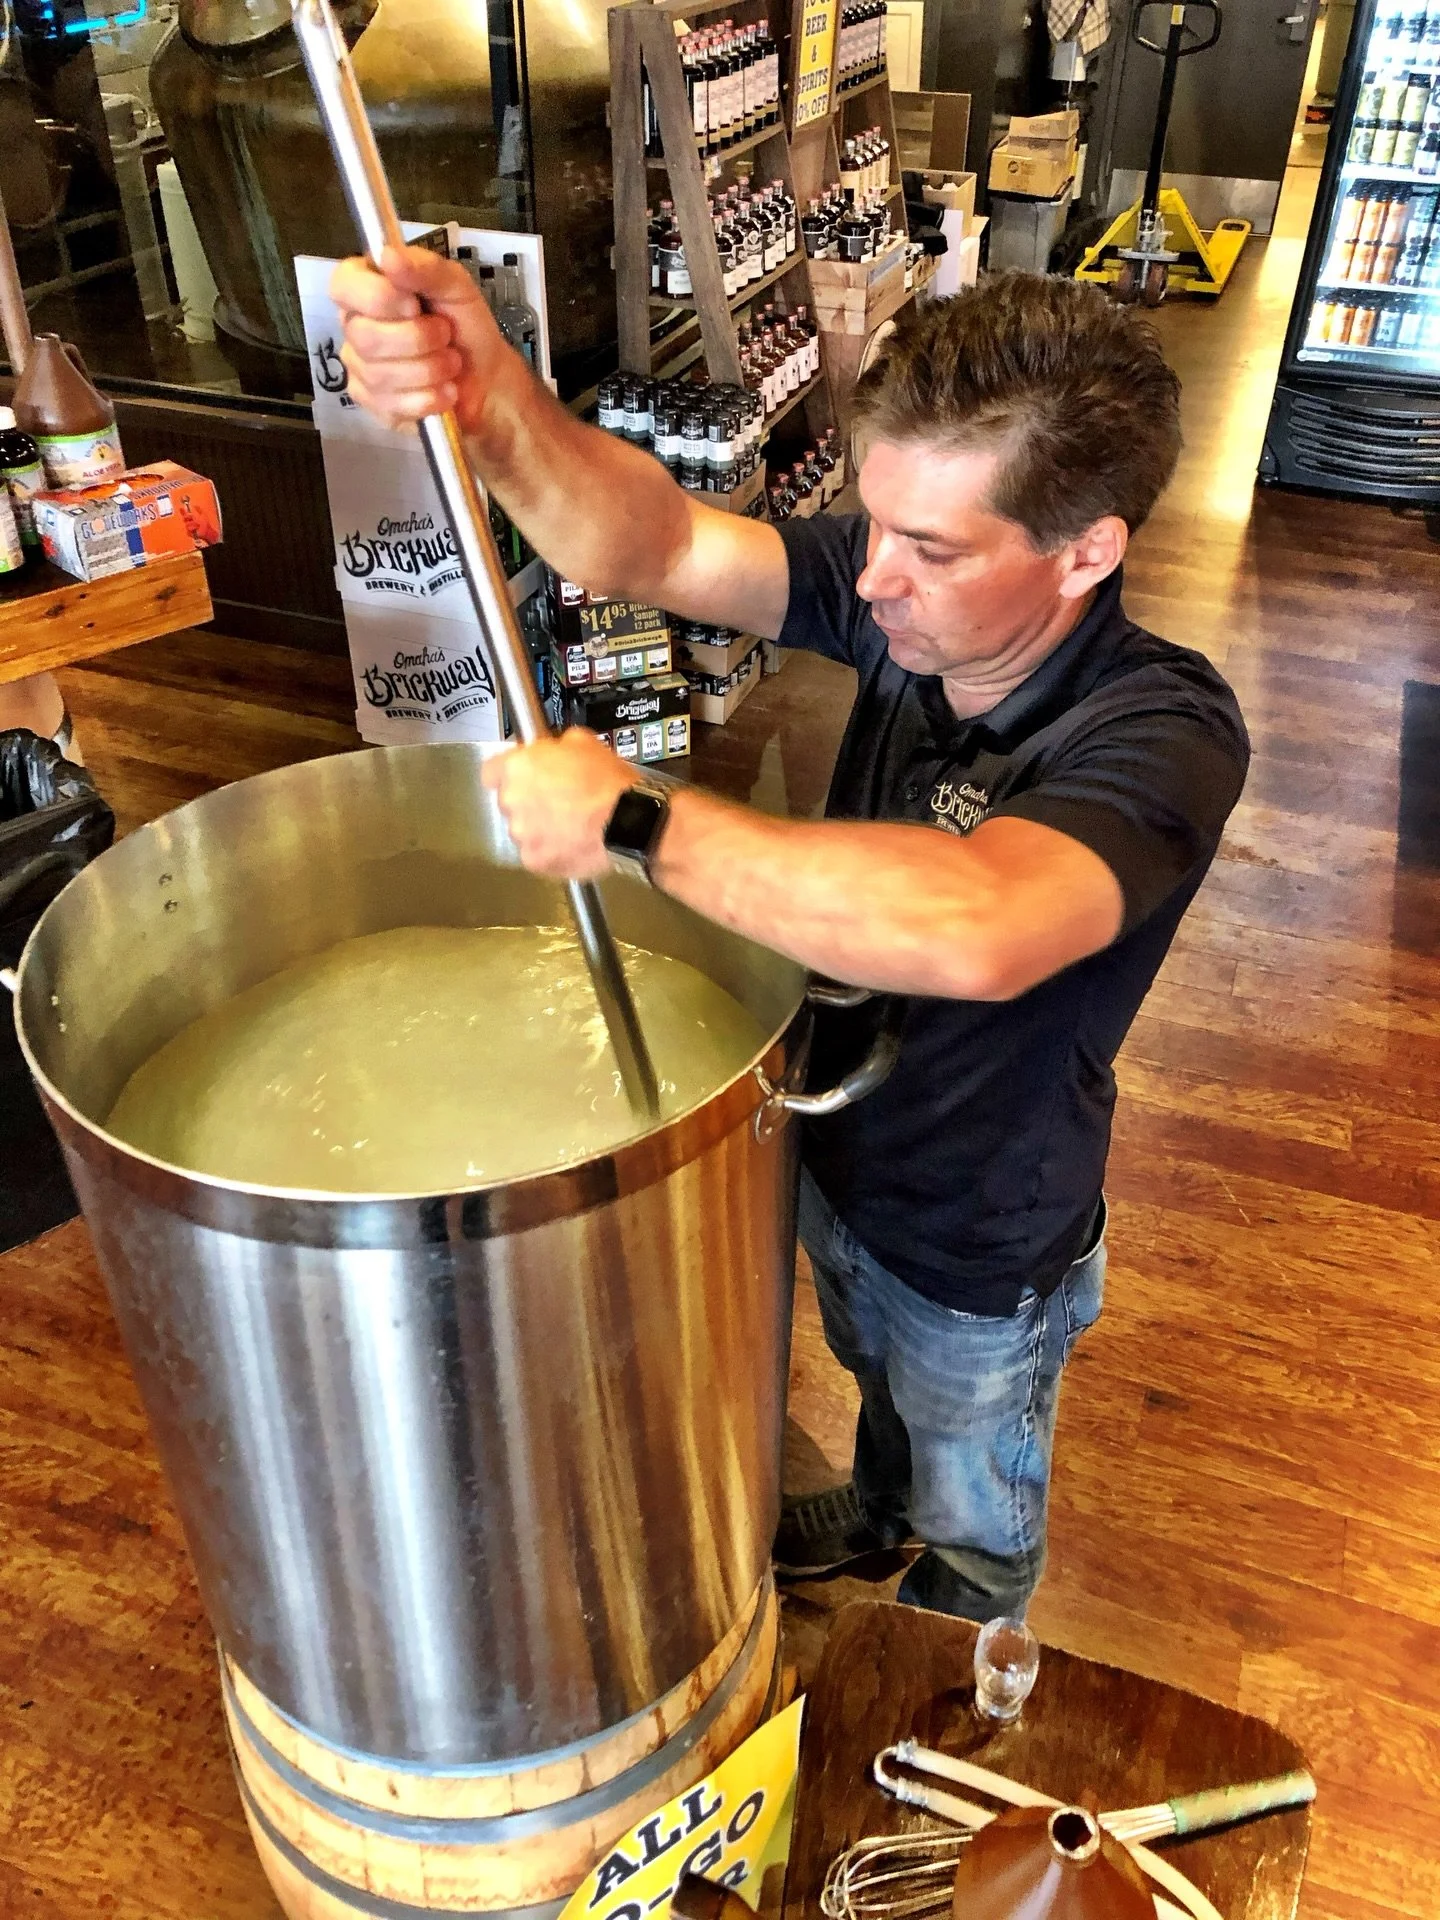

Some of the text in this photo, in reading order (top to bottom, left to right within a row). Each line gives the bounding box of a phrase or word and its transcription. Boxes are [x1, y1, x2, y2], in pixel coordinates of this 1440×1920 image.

[805, 14, 827, 36] BEER
[811, 44, 818, 62] &
[799, 67, 828, 93] PIRITS
[811, 94, 828, 115] OFF
[377, 511, 434, 537] Omaha's
[340, 528, 460, 577] Brickwa
[365, 580, 415, 593] BREWERY
[633, 609, 660, 621] Sample
[393, 646, 446, 669] Omaha's
[360, 645, 496, 708] Brickway
[385, 708, 431, 720] BREWERY
[444, 696, 489, 719] DISTILLERY
[615, 697, 660, 718] Brickway
[589, 1786, 723, 1909] ALL
